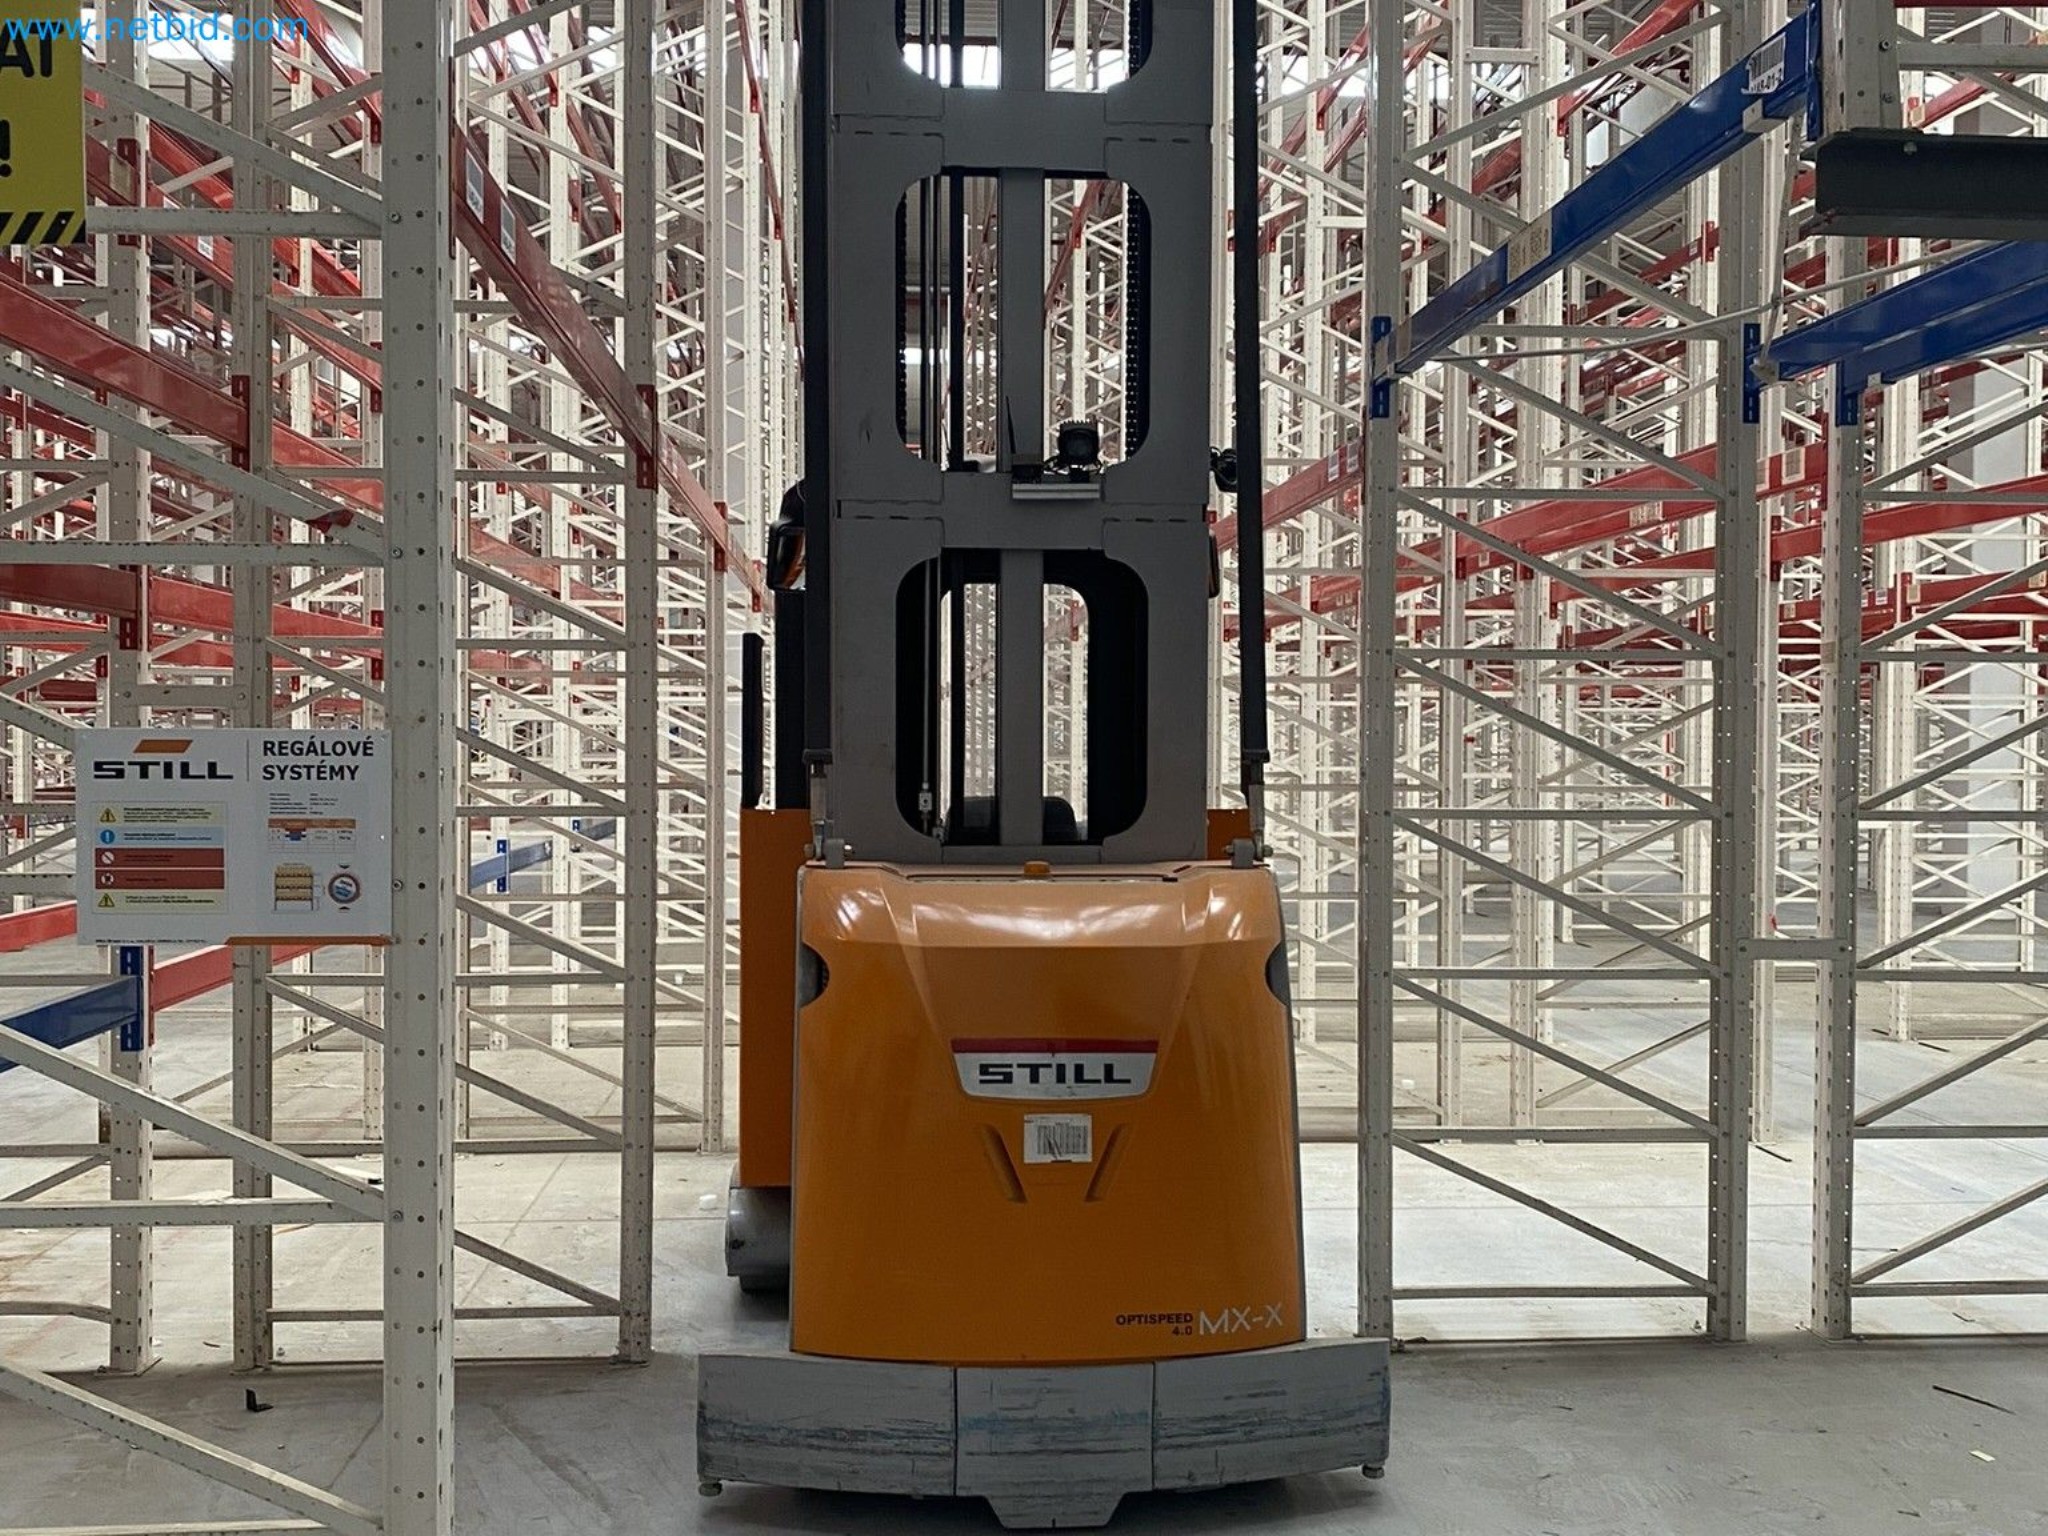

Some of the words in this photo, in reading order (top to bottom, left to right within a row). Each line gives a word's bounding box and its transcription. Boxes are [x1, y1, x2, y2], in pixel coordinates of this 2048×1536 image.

[262, 736, 374, 757] REGÁLOVÉ
[93, 761, 234, 780] STILL
[262, 760, 360, 781] SYSTÉMY
[978, 1063, 1132, 1085] STILL
[1115, 1313, 1193, 1325] OPTISPEED
[1199, 1302, 1283, 1336] MX-X
[1172, 1325, 1193, 1337] 4.0
